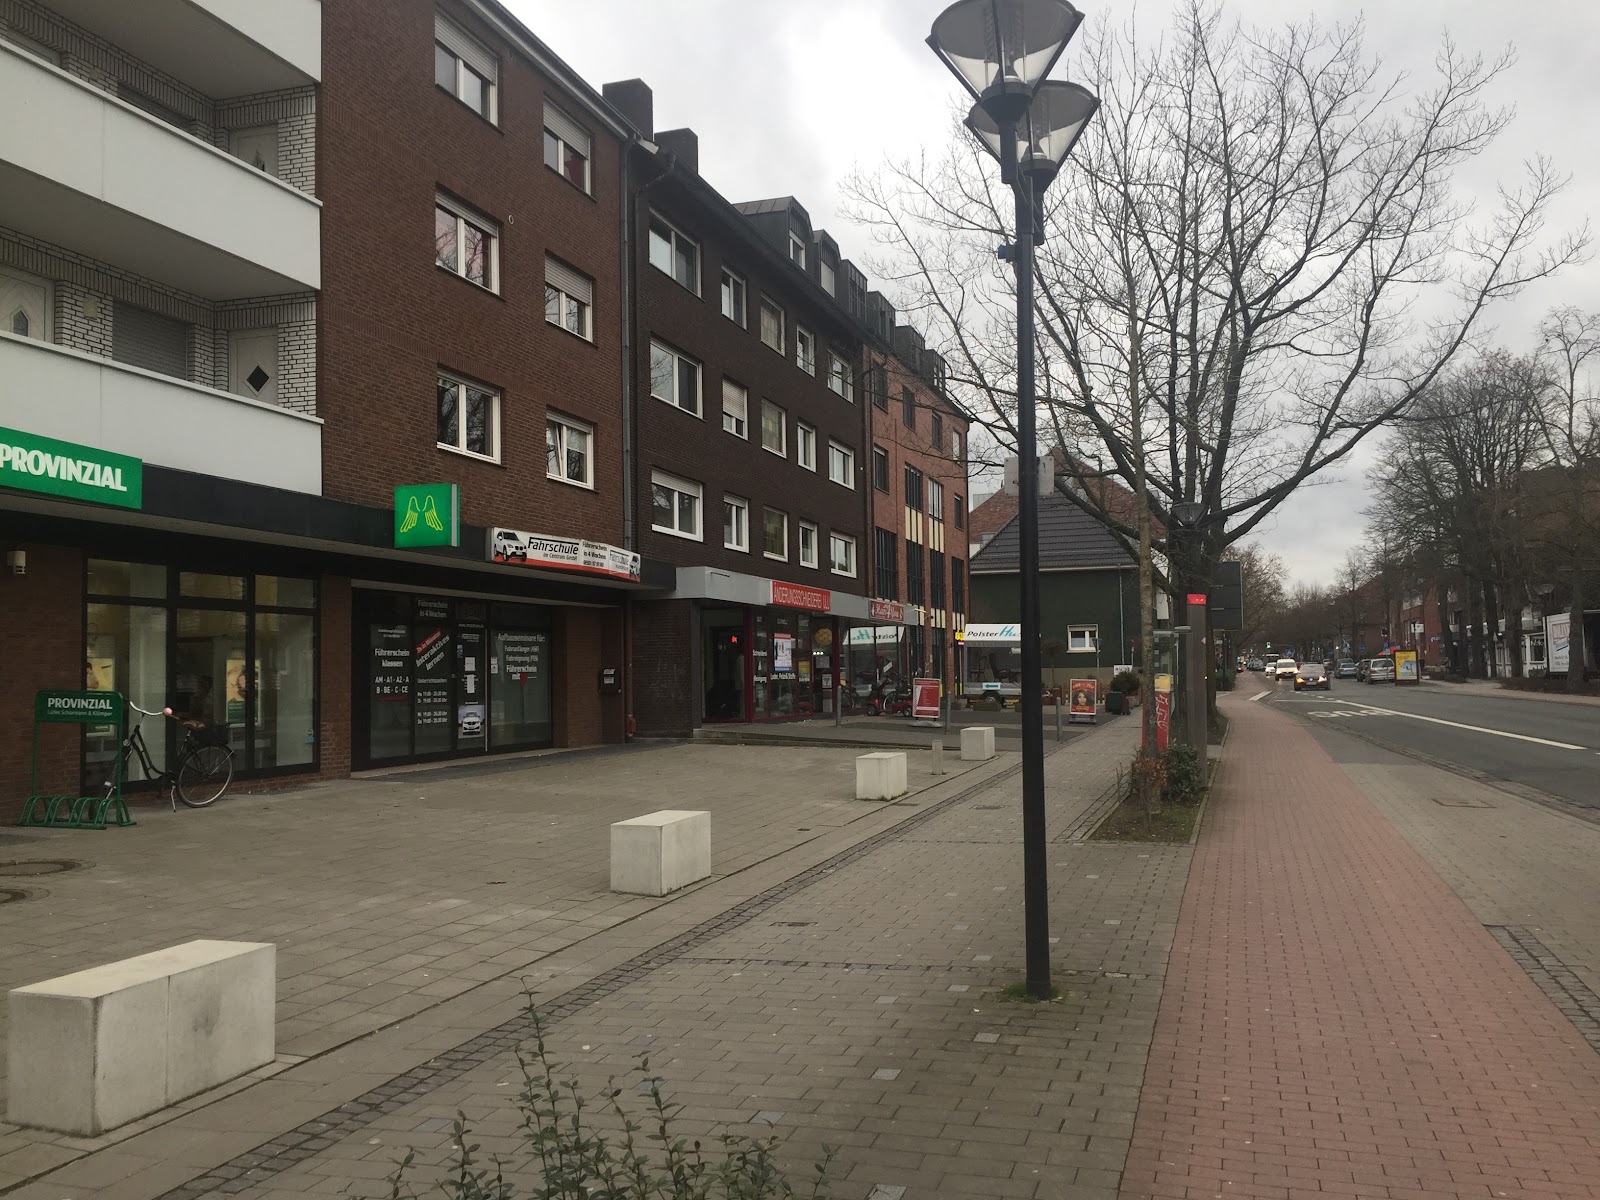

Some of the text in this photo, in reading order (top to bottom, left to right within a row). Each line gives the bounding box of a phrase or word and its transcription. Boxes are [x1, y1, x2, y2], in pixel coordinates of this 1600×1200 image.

[0, 443, 127, 491] PROVINZIAL
[528, 537, 579, 555] Fahrschule
[375, 648, 410, 656] Führerschein
[506, 664, 537, 672] Führerschein
[384, 686, 390, 694] BE
[48, 698, 113, 710] PROVINZIAL
